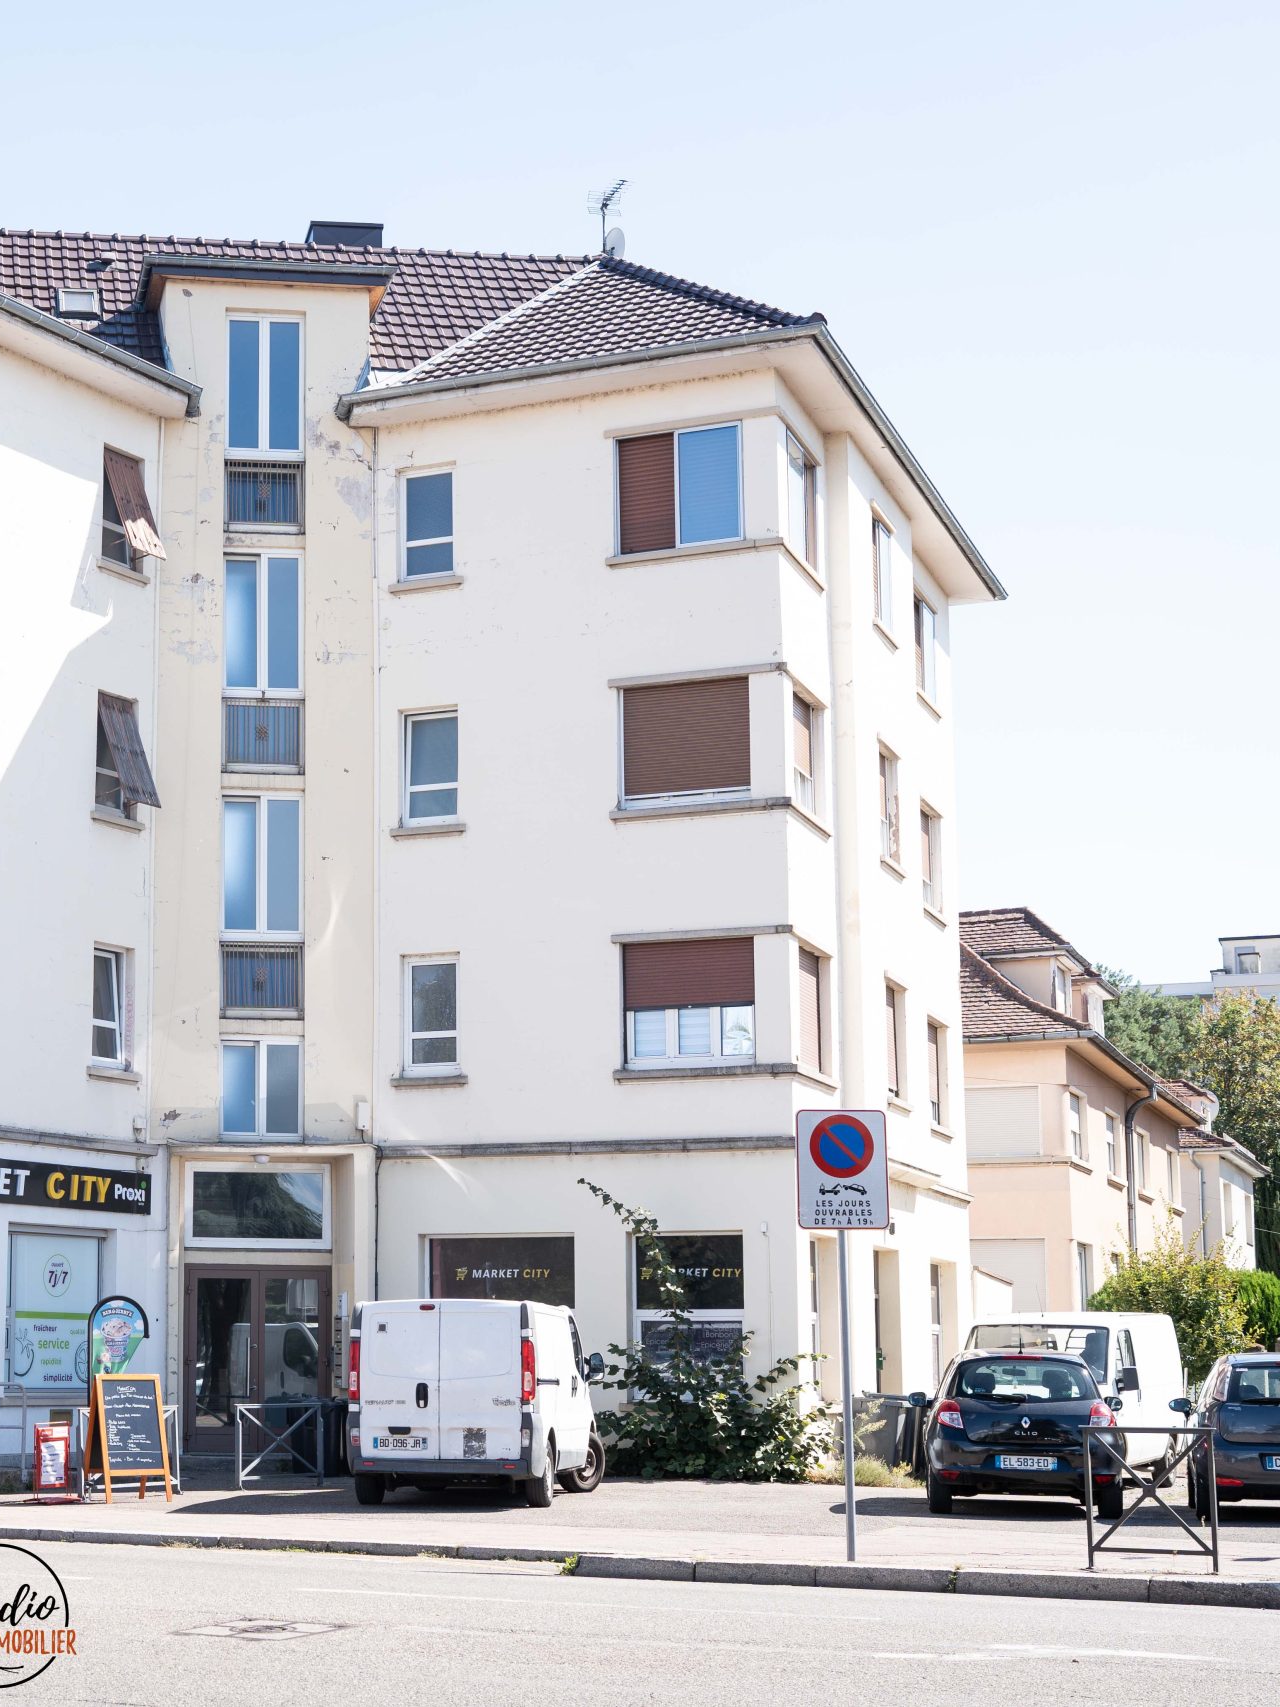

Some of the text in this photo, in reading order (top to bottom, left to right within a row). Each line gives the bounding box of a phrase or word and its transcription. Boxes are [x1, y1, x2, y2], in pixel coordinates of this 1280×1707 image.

[46, 1172, 112, 1203] CITY
[114, 1180, 146, 1202] Proxi
[48, 1269, 68, 1287] 7j/7
[472, 1269, 550, 1278] MARKET CITY
[712, 1268, 742, 1278] CITY
[38, 1339, 70, 1349] service
[43, 1374, 72, 1383] simplicité
[1002, 1458, 1049, 1468] EL-583-ED
